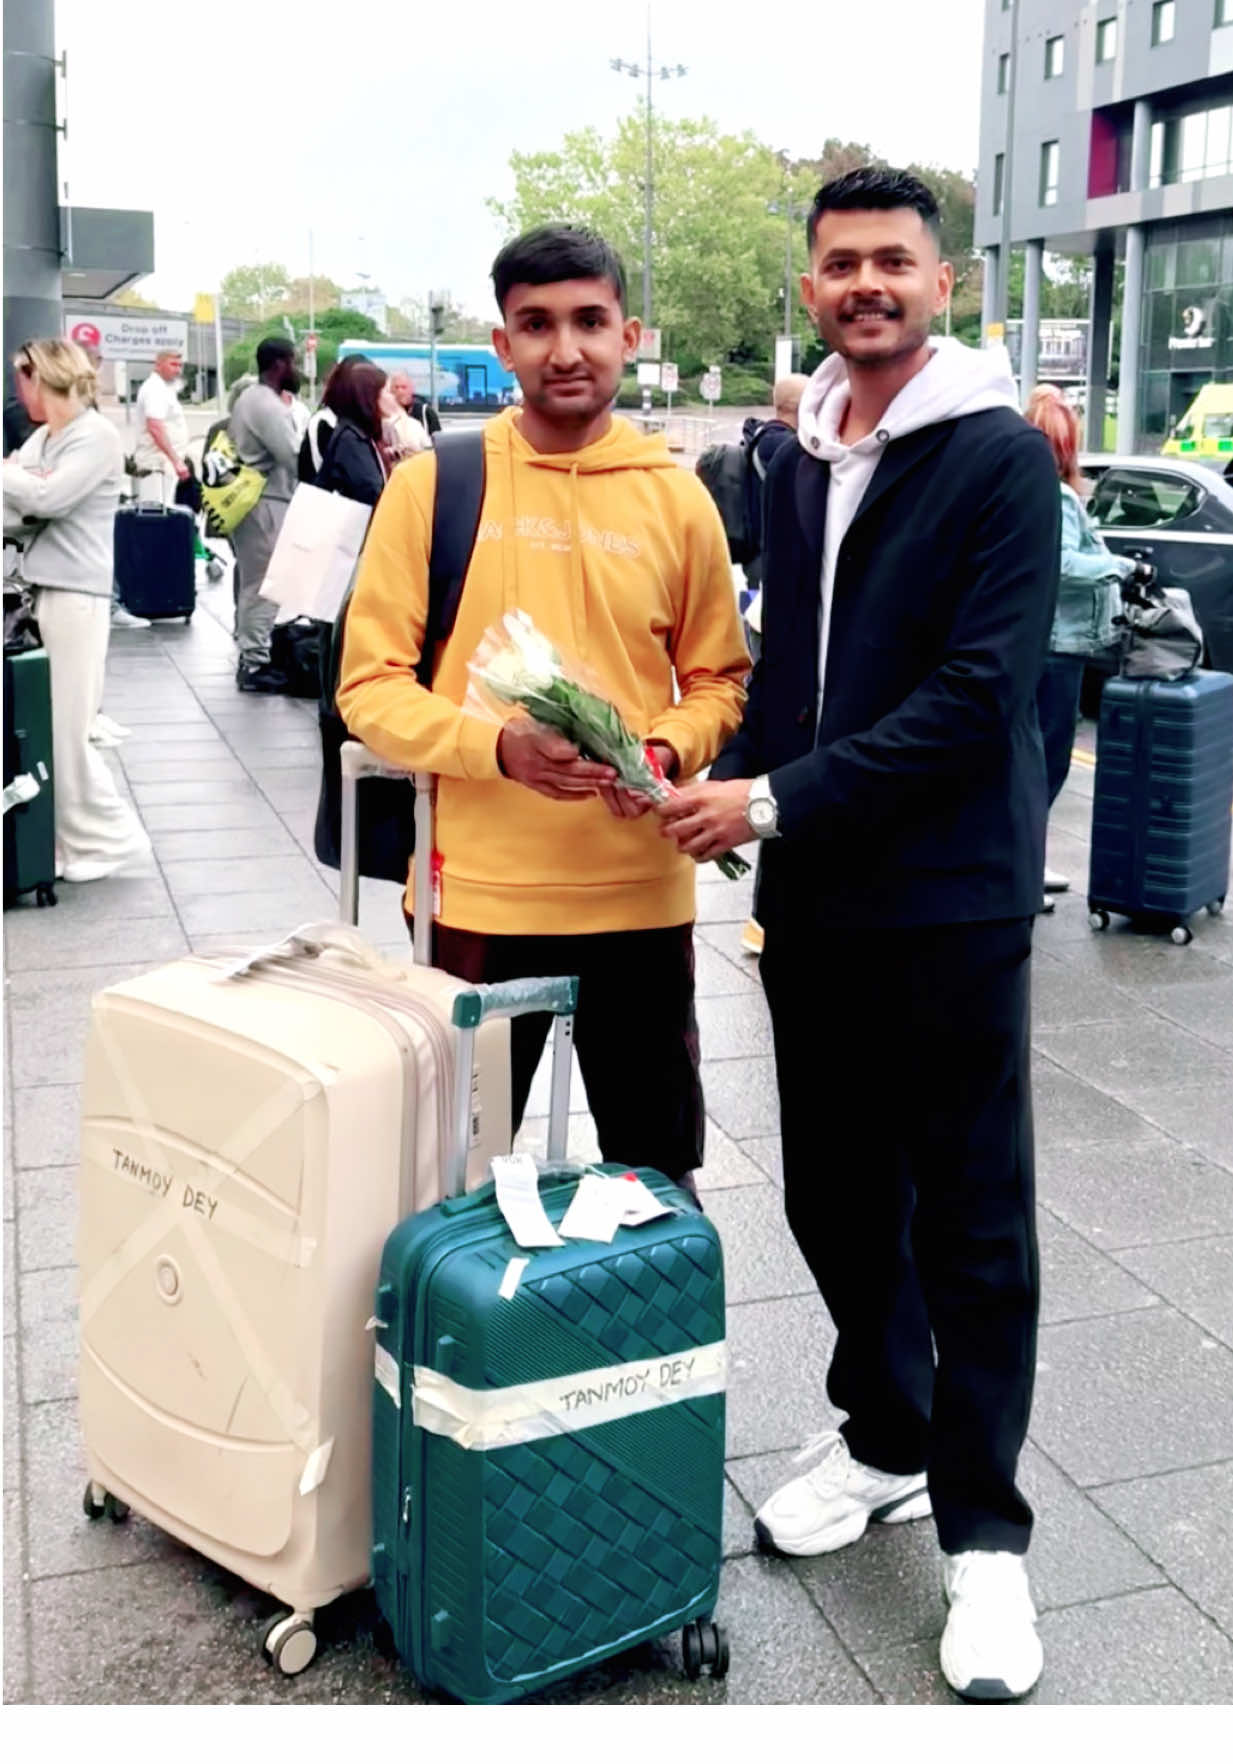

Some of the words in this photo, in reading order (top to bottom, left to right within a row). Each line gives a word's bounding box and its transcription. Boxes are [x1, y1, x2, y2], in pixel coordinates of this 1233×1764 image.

[105, 334, 151, 345] Charges
[155, 336, 184, 347] apply
[121, 323, 149, 334] Drop
[152, 323, 168, 334] off
[112, 1147, 174, 1198] TANMOY
[182, 1183, 218, 1221] DEY
[559, 1369, 650, 1411] TANMOY
[659, 1357, 696, 1388] DEY
